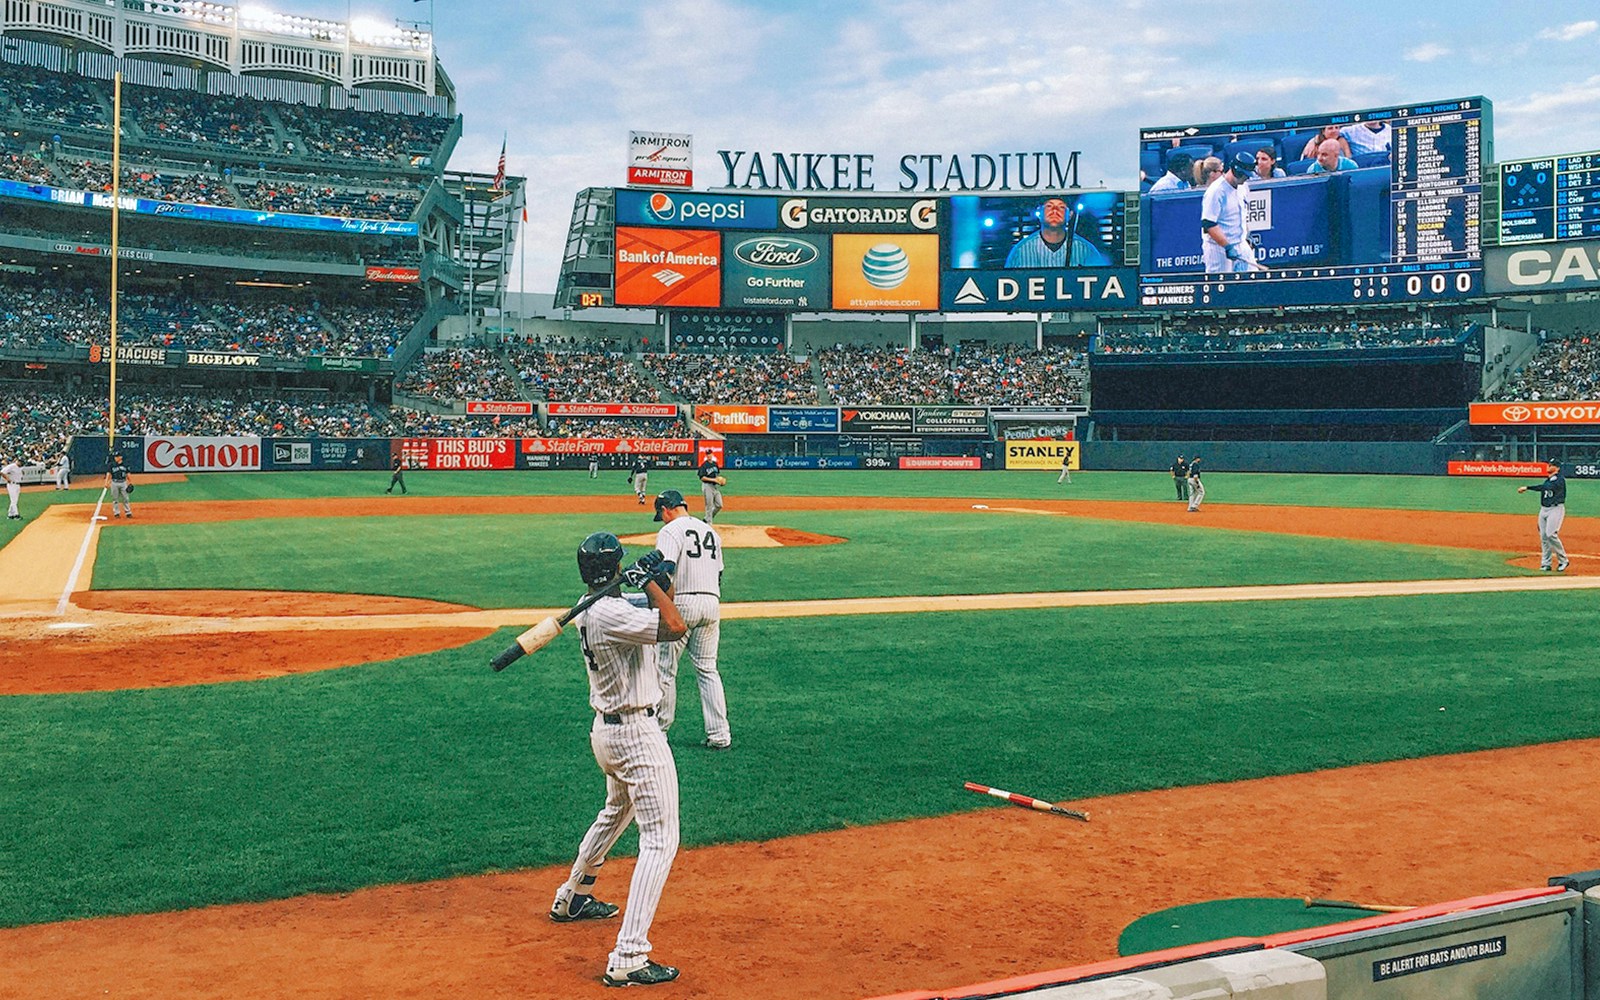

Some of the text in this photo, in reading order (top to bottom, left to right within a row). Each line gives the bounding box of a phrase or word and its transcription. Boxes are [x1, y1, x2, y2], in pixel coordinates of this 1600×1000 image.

[1434, 104, 1458, 112] PITCHES
[1432, 114, 1462, 123] MARINERS
[632, 136, 690, 147] ARMITRON
[634, 169, 687, 179] ARMITRON
[718, 151, 1082, 191] YANKEE STADIUM
[1505, 164, 1522, 173] LAD
[1531, 161, 1552, 170] WSH
[51, 189, 84, 204] BRIAN
[681, 200, 744, 223] pepsi
[810, 208, 907, 223] GATORADE
[342, 220, 413, 234] New York Yankees
[76, 246, 153, 260] Audi YAKEES CLUB
[619, 250, 717, 265] Bank of America
[750, 241, 801, 264] Ford
[1156, 258, 1173, 268] THE
[1174, 254, 1204, 266] OFFICIA
[1269, 248, 1286, 259] CAP
[1288, 247, 1300, 256] OF
[1507, 246, 1600, 286] CA
[366, 269, 419, 279] Budweiser
[747, 277, 805, 288] Go Further
[998, 276, 1124, 300] DELTA
[1407, 273, 1471, 295] 0 0 0
[1158, 286, 1194, 294] MARINERS
[582, 294, 602, 306] 0:27
[743, 297, 794, 306] tristateford.com
[1158, 295, 1193, 304] YANKEES
[102, 347, 166, 360] SRACUSE
[322, 358, 362, 368] Poland Spring
[713, 412, 765, 426] DraftKings
[858, 411, 911, 420] YOKOHAMA
[1004, 429, 1036, 440] Peanut
[1038, 425, 1068, 436] Chews
[436, 440, 506, 453] THIS BUD'S
[1010, 447, 1074, 457] STANLEY
[147, 440, 259, 468] Canon
[436, 454, 461, 468] FOR
[465, 454, 492, 468] YOU.
[685, 529, 717, 560] 34
[1380, 940, 1501, 976] BE ALERT FOR BATS AND/OR BALLS
